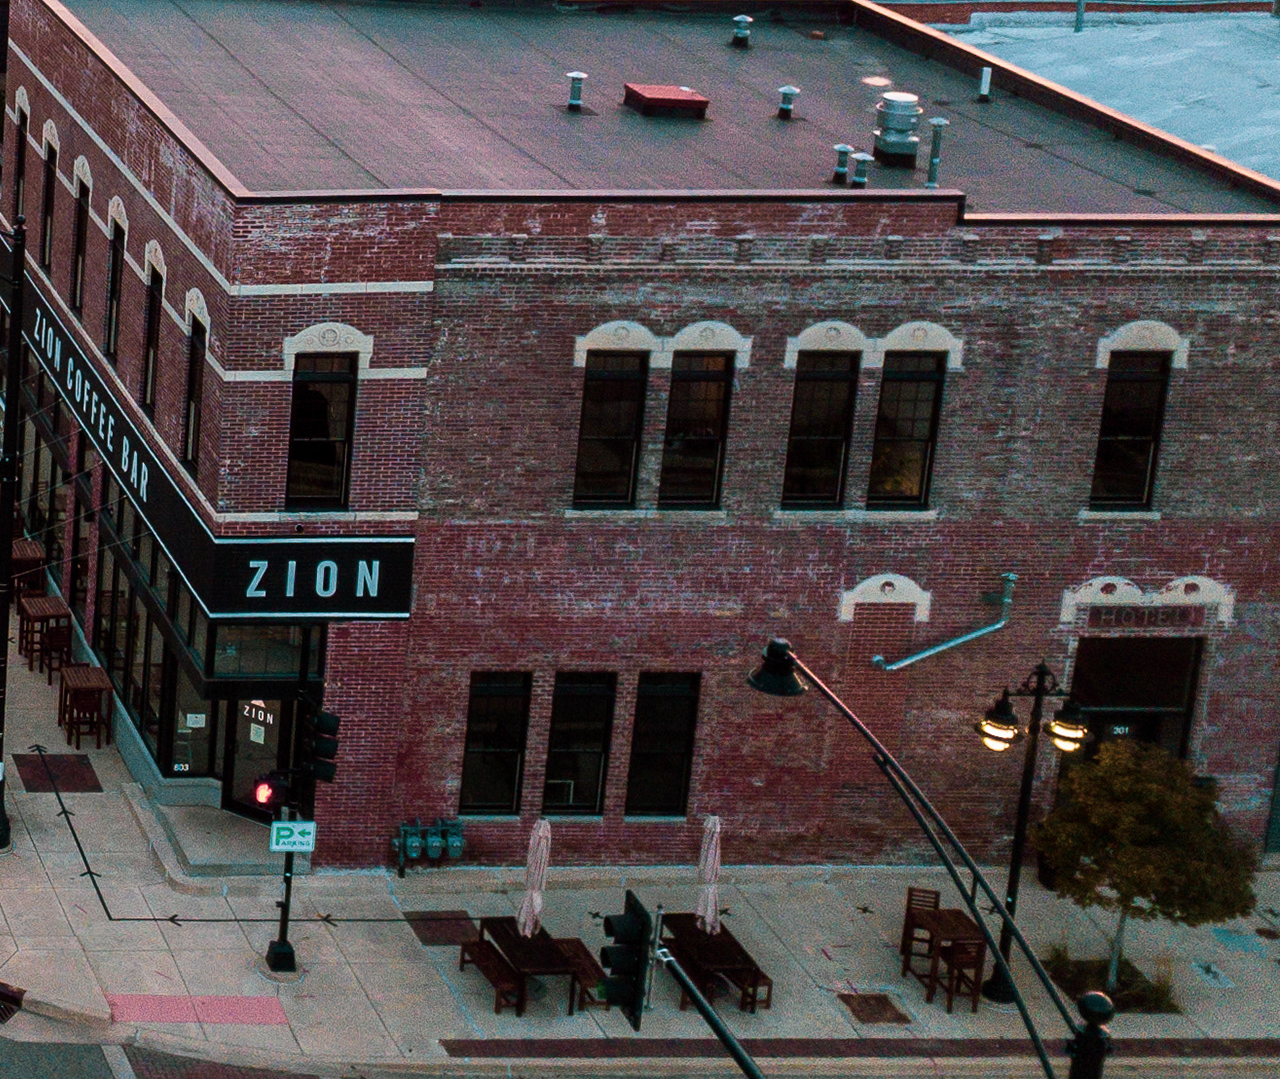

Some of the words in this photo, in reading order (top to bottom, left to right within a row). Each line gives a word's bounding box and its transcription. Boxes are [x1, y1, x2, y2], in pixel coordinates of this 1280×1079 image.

[34, 308, 61, 371] ZION
[66, 357, 115, 452] COFFEE
[121, 435, 149, 503] BAR
[246, 560, 380, 597] ZION
[243, 705, 274, 725] ZION
